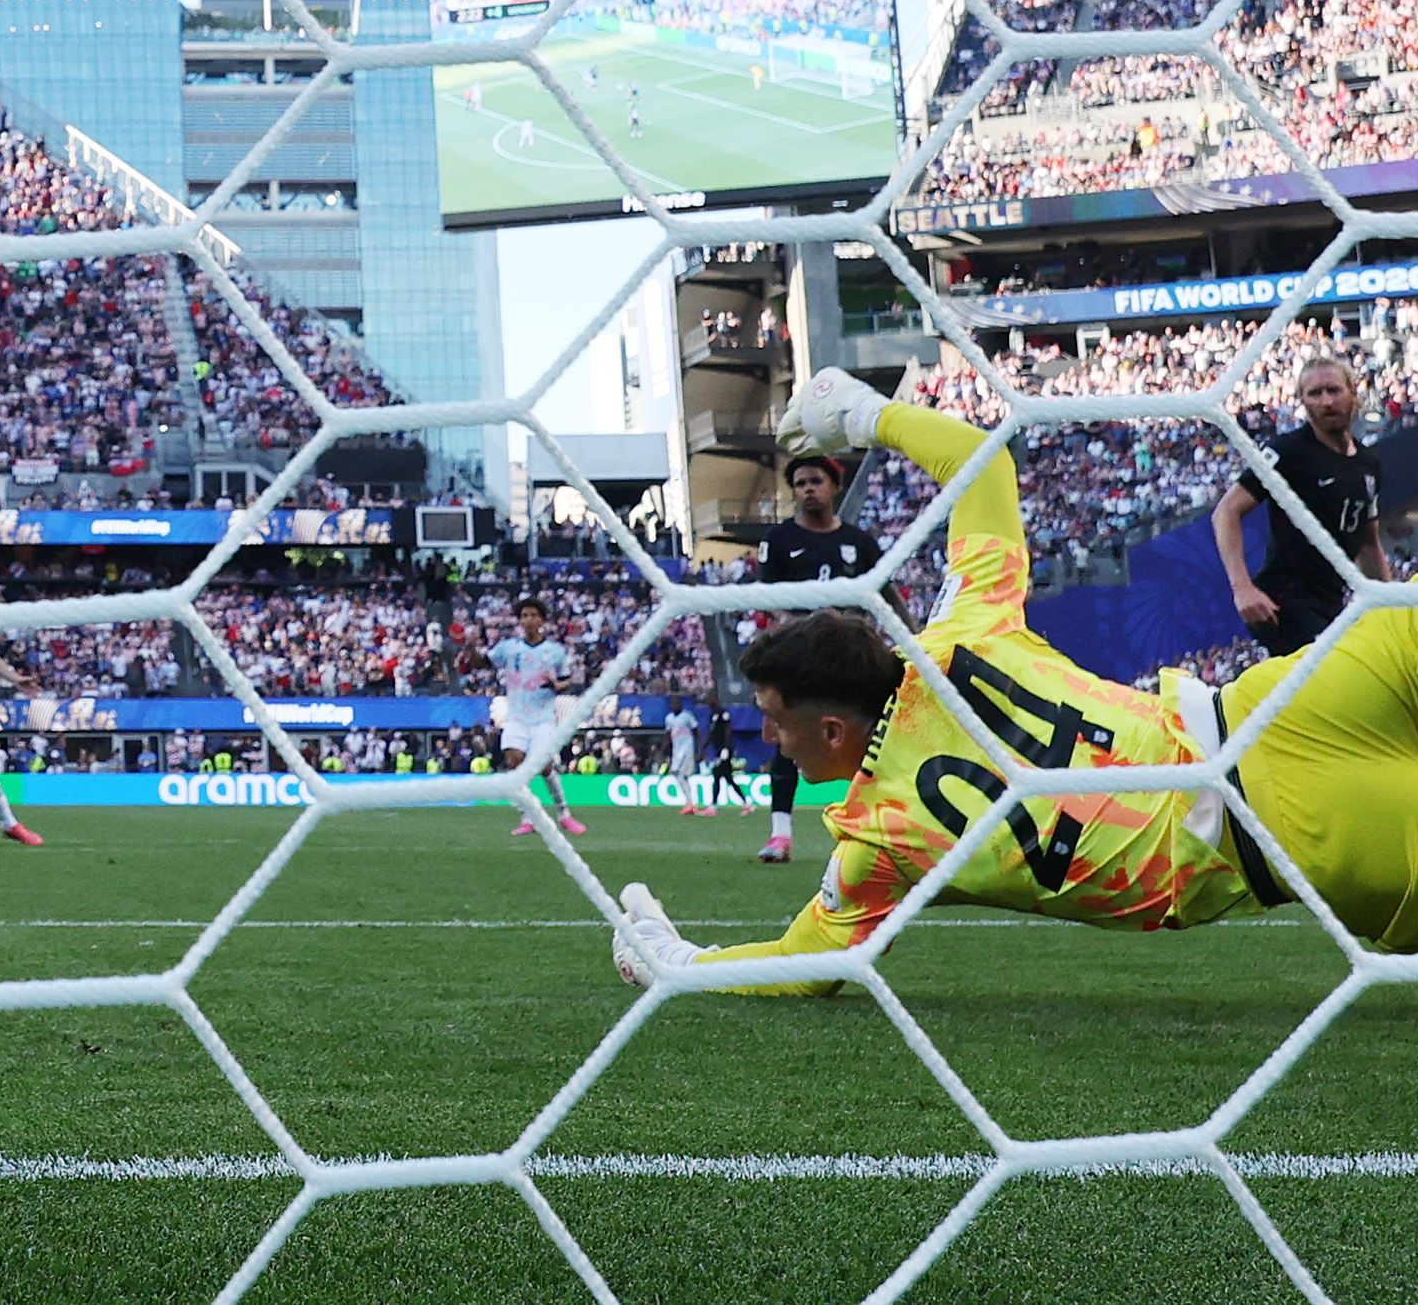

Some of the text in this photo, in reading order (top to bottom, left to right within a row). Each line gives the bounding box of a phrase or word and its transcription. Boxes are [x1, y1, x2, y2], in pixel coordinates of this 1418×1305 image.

[897, 200, 1024, 234] SEATTLE
[1114, 286, 1174, 314] FIFA
[1174, 279, 1275, 309] WORLD
[1339, 497, 1365, 533] 13
[916, 644, 1115, 894] 24
